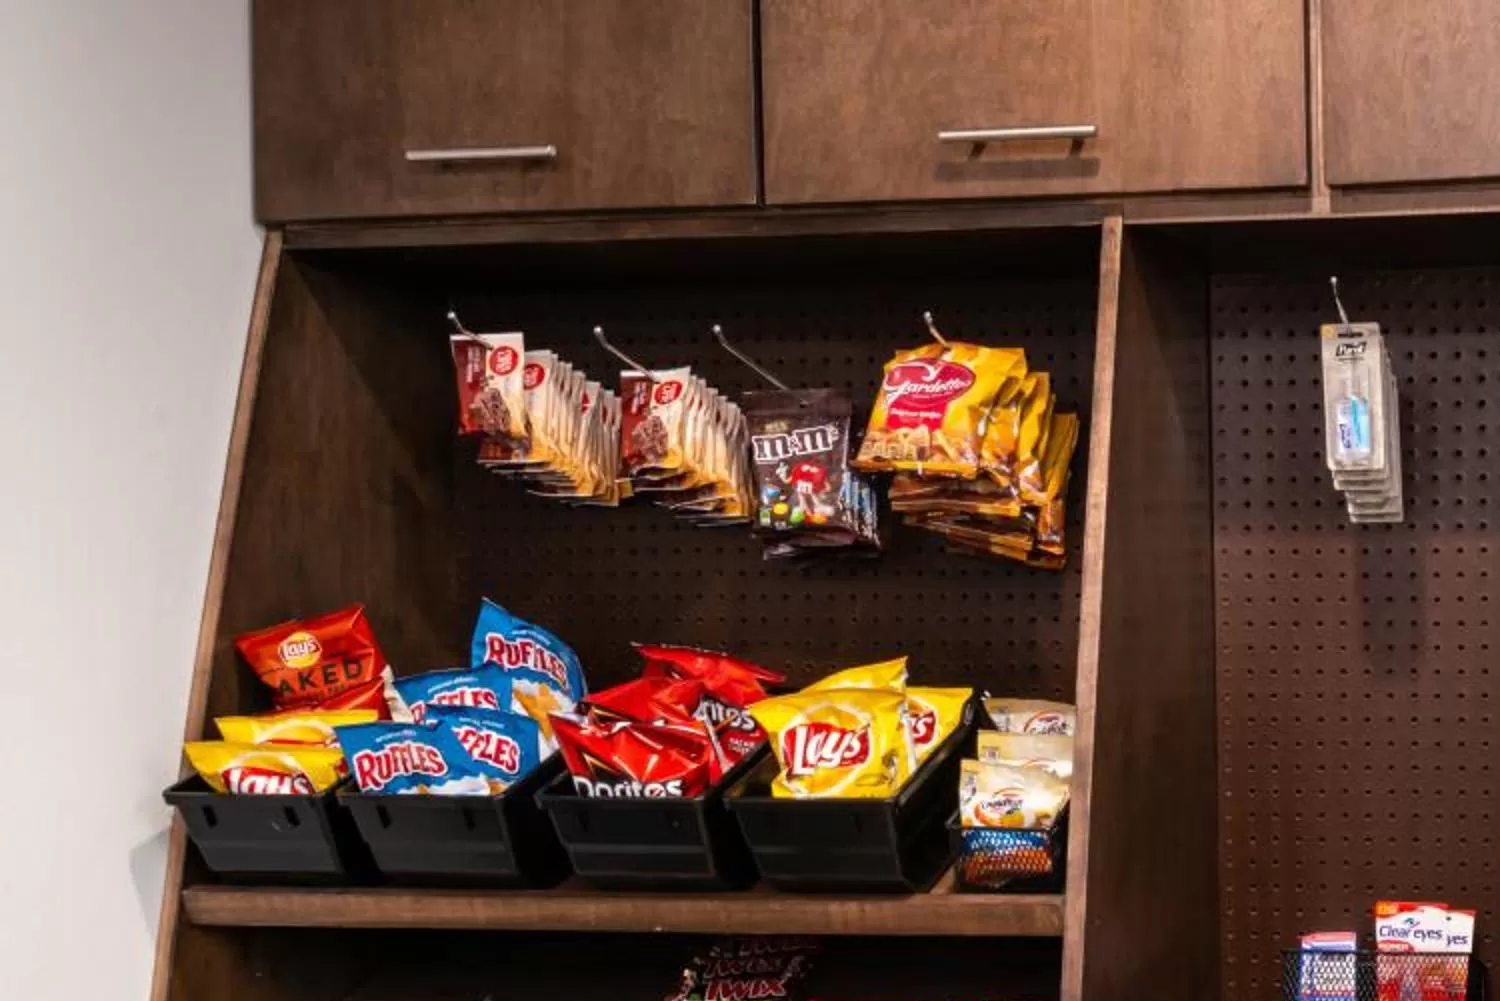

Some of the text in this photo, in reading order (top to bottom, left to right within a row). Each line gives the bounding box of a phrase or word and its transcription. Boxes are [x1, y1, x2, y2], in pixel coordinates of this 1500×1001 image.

[279, 657, 363, 691] AKED
[354, 743, 447, 789] RUFFLES
[453, 726, 521, 774] FFLES
[787, 722, 868, 775] Lay's
[1379, 924, 1412, 939] Clear
[1413, 927, 1443, 946] eyes
